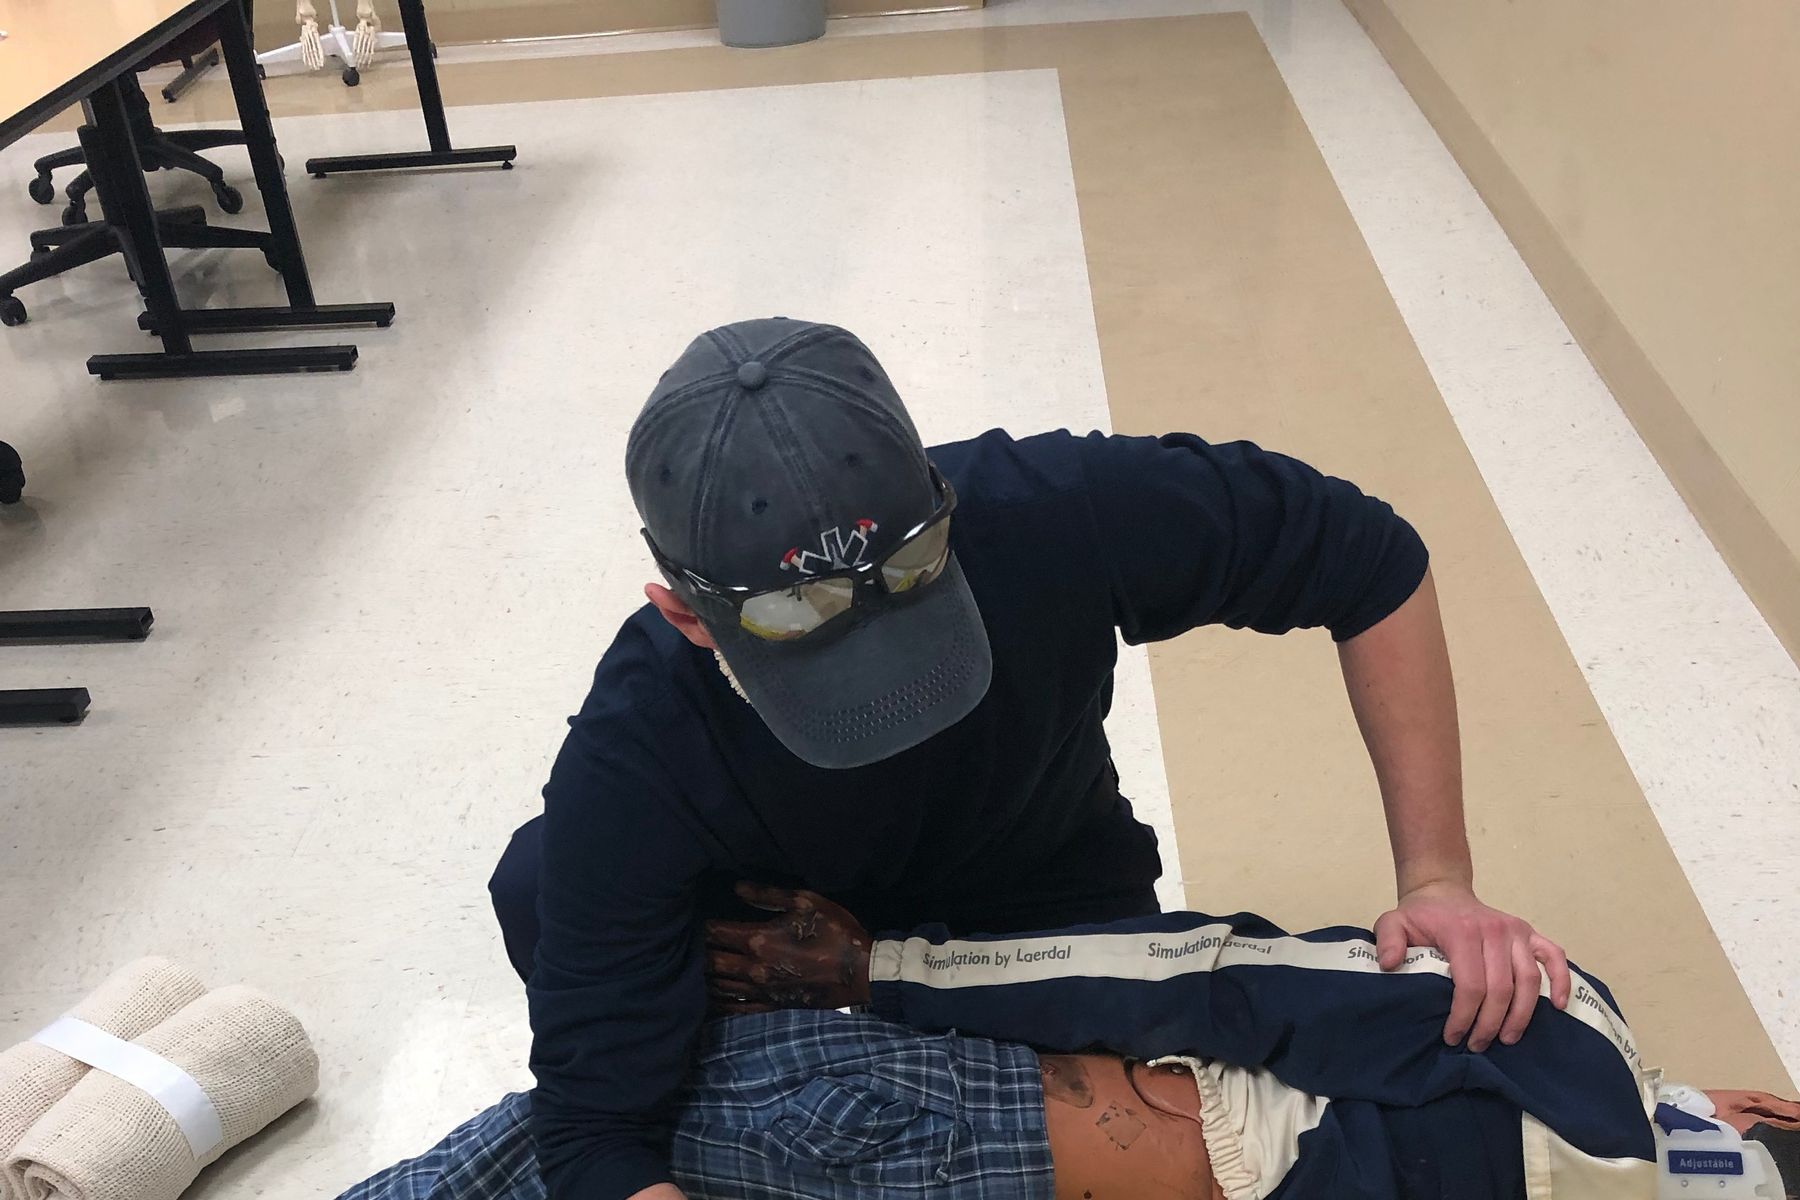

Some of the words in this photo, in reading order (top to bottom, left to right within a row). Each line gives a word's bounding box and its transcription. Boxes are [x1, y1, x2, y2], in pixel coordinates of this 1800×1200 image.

[923, 950, 990, 970] Simulation
[995, 951, 1011, 969] by
[1016, 945, 1071, 963] Laerdal
[1148, 936, 1222, 959] Simulation
[1223, 941, 1272, 954] aerdal
[1624, 1040, 1637, 1059] by
[1680, 1158, 1735, 1169] Adjustable
